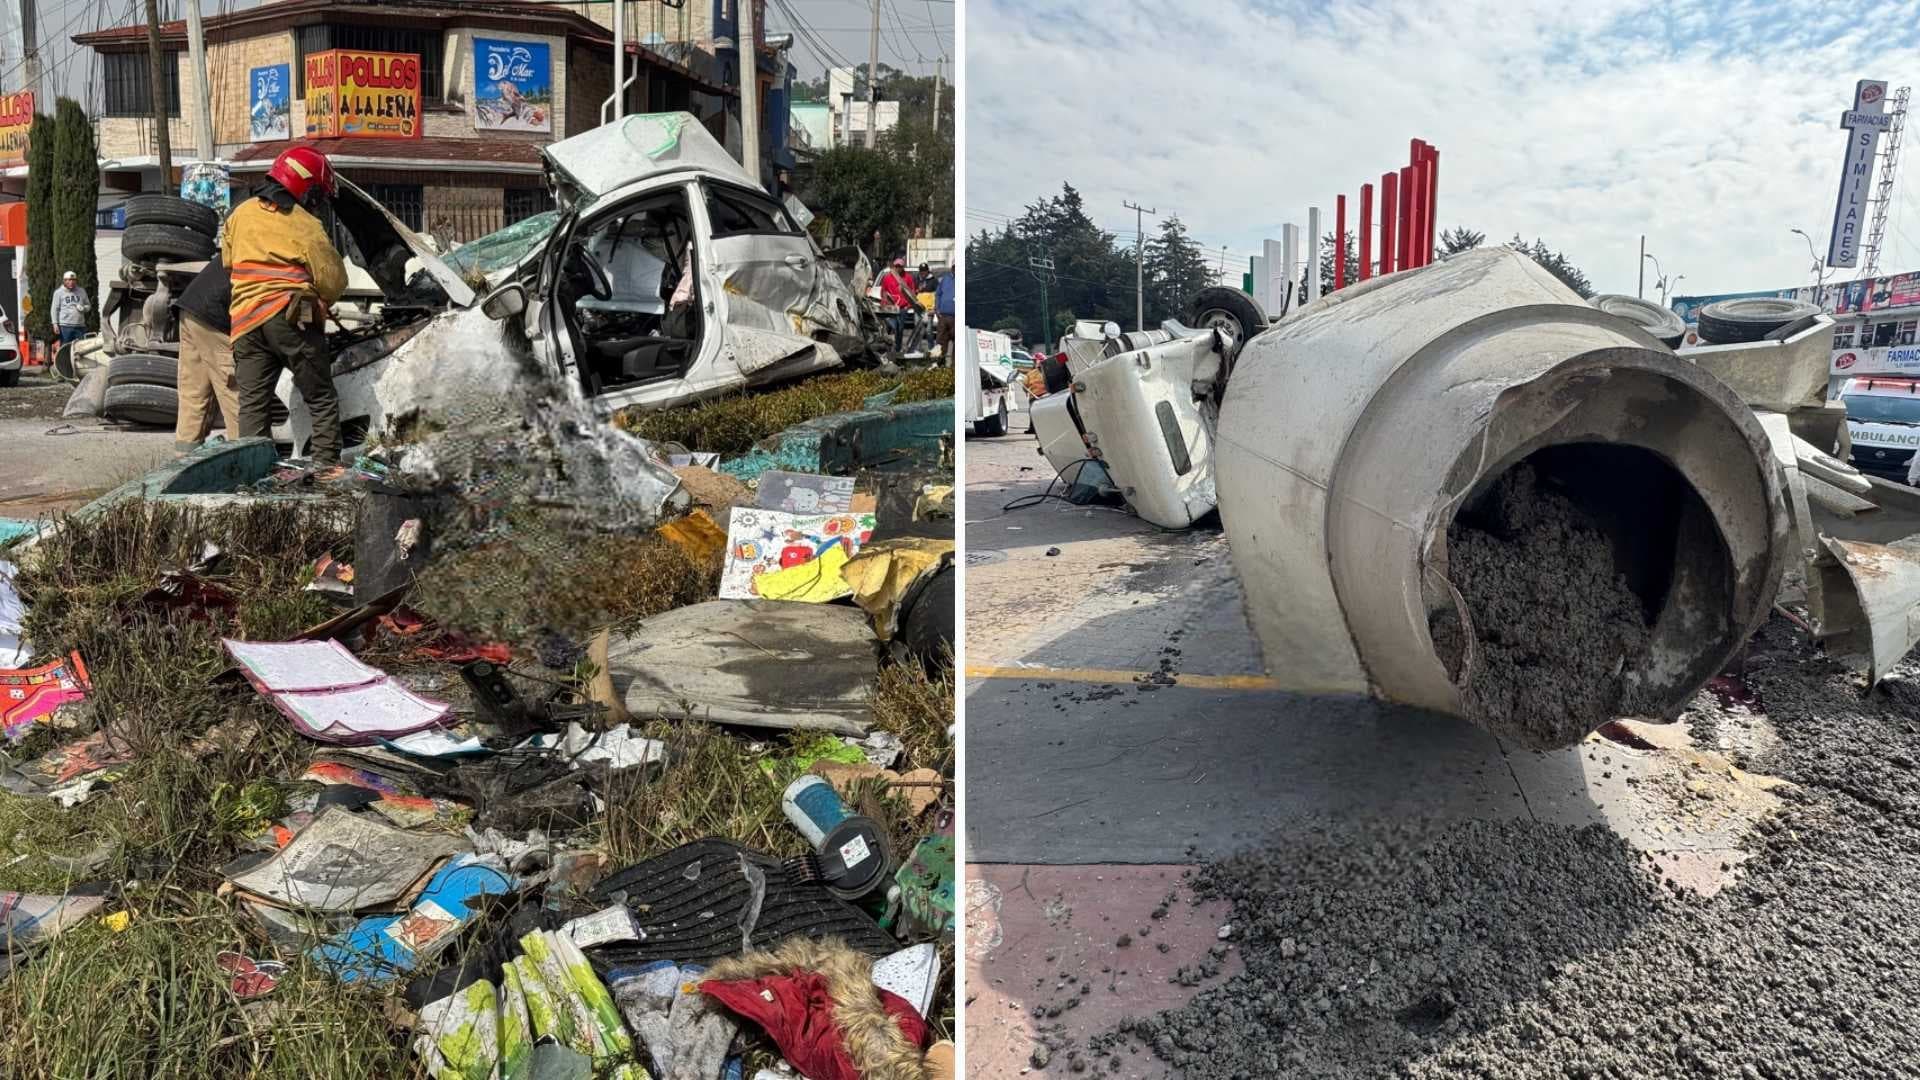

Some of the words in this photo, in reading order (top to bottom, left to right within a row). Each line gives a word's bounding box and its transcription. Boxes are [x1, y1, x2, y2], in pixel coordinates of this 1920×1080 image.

[340, 55, 417, 89] POLLOS
[340, 94, 350, 116] A
[355, 95, 374, 117] LA
[1848, 112, 1889, 126] FARMACIAS
[1839, 133, 1871, 263] SIMILARES
